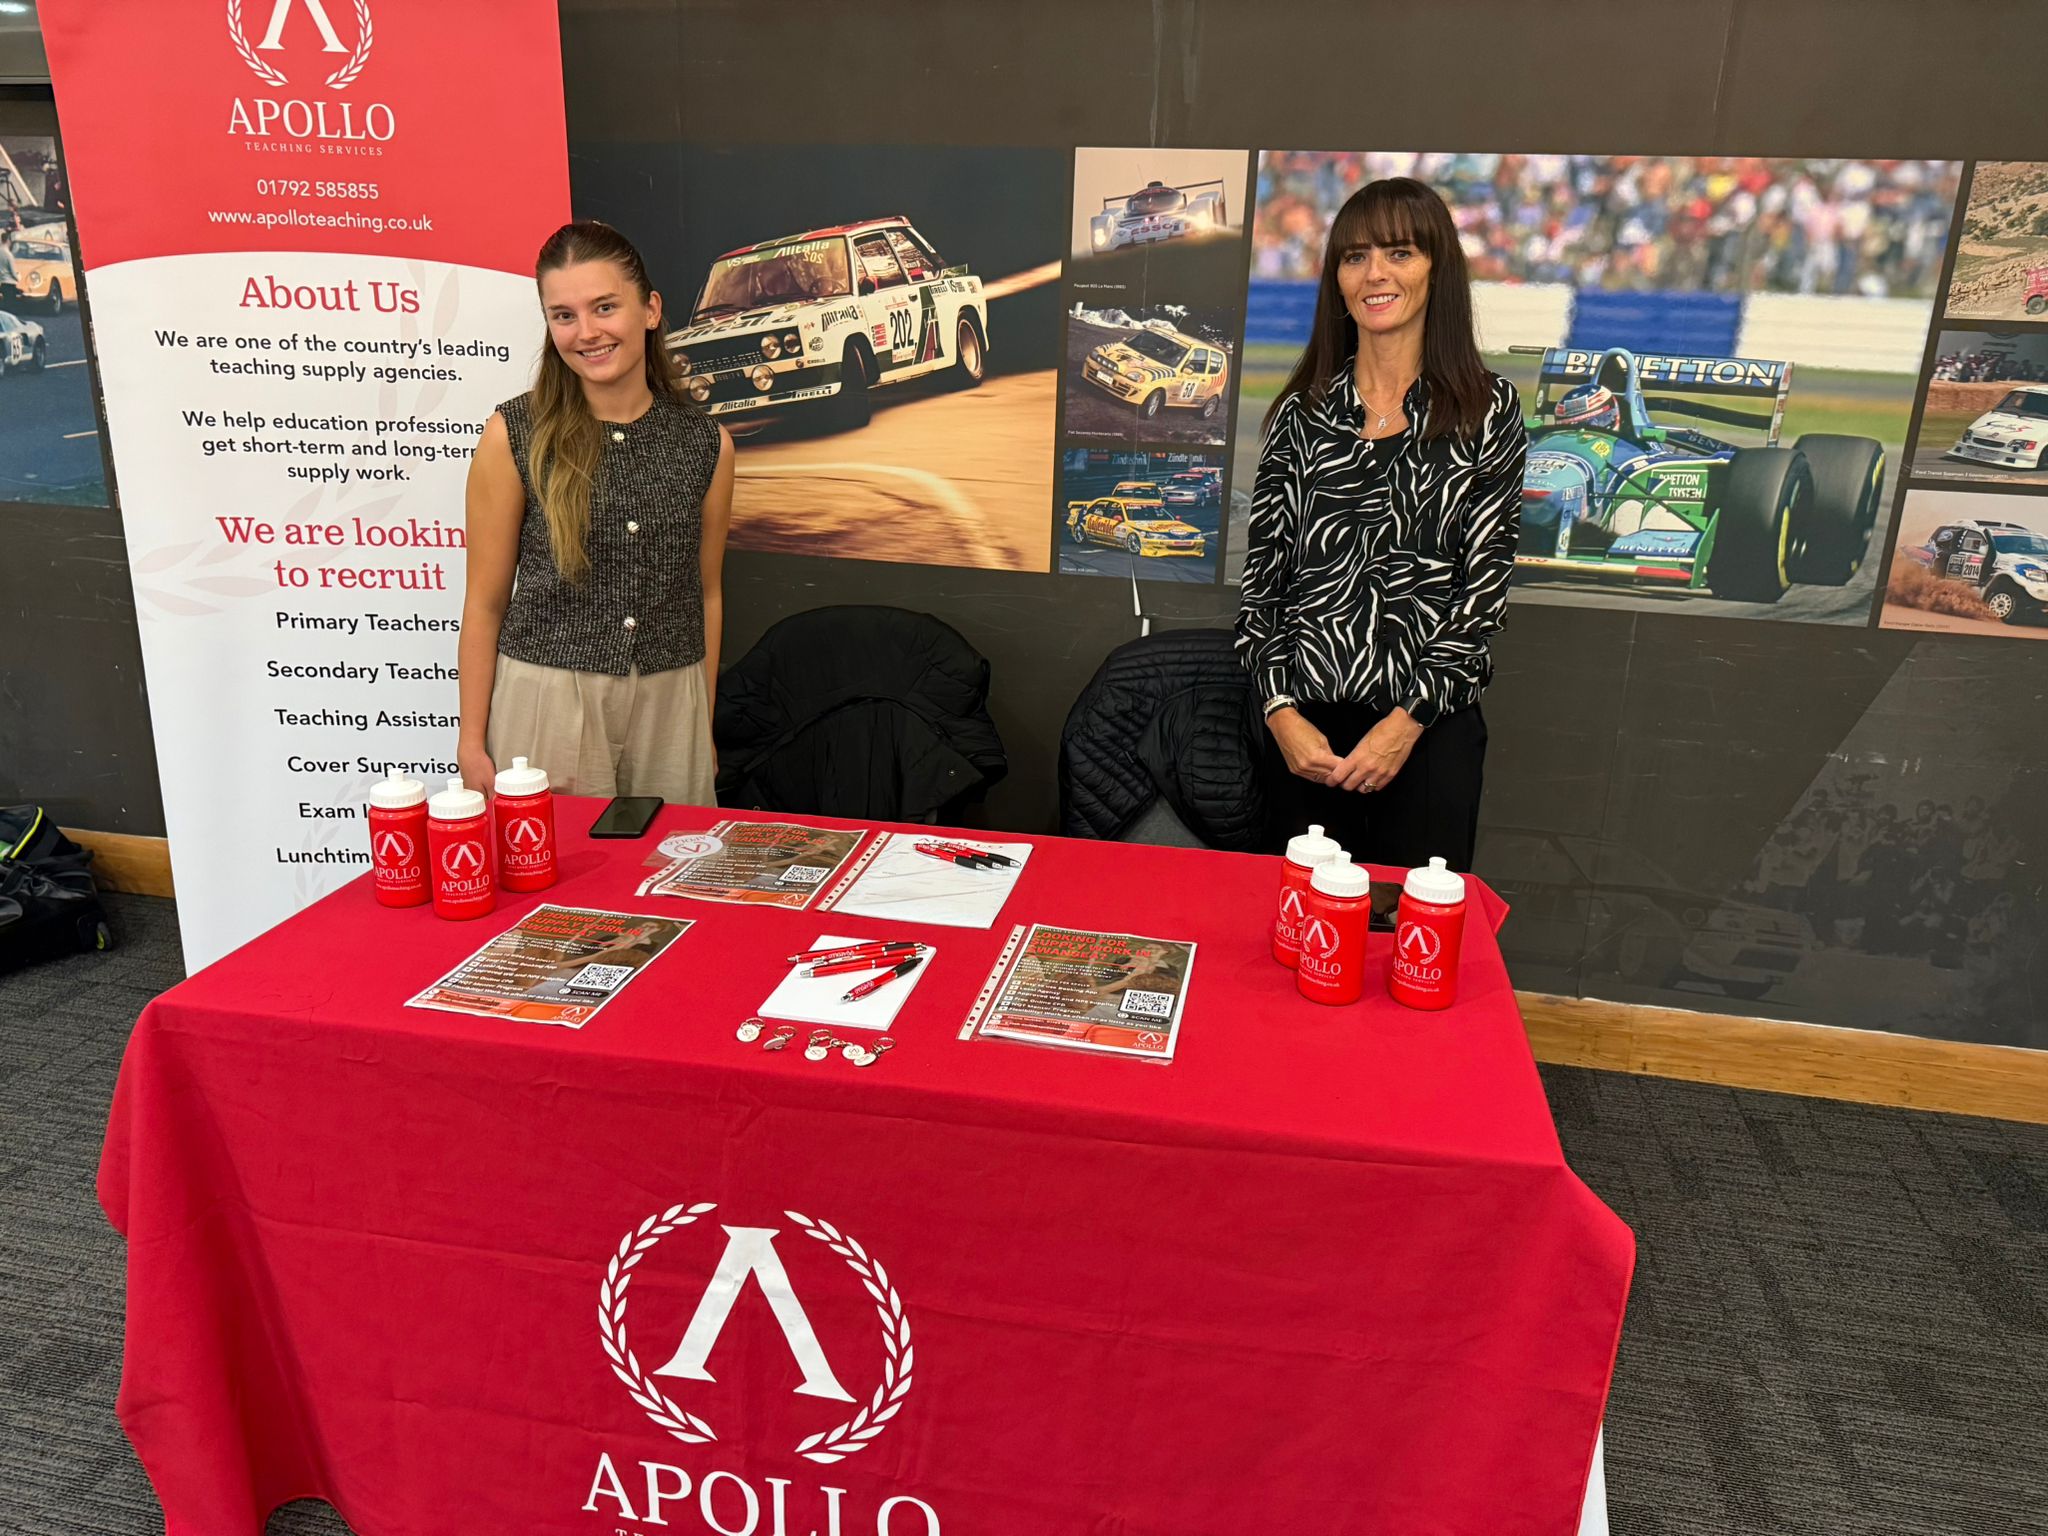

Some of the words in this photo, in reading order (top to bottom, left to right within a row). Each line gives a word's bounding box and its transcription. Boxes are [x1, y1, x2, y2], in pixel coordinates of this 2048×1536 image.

[228, 97, 395, 141] APOLLO
[245, 142, 312, 153] TEACHING
[319, 144, 383, 156] SERVICES
[257, 179, 310, 196] 01792
[316, 181, 379, 199] 585855
[208, 209, 433, 233] www.apolloteaching.co.uk
[1131, 223, 1173, 236] ESSO
[774, 241, 830, 258] Alitalia
[239, 275, 360, 311] About
[368, 281, 420, 313] Us
[890, 308, 914, 350] 202
[155, 330, 188, 347] We
[197, 334, 228, 349] are
[235, 337, 271, 350] one
[279, 334, 298, 351] of
[305, 335, 337, 352] the
[344, 339, 431, 359] country's
[438, 339, 509, 362] leading
[210, 358, 295, 379] teaching
[302, 362, 366, 382] supply
[374, 364, 462, 383] agencies.
[1182, 382, 1195, 399] 58
[719, 398, 756, 412] Alitalia
[182, 410, 216, 427] We
[224, 411, 265, 431] help
[273, 413, 368, 431] education
[202, 437, 236, 456] get
[243, 437, 345, 455] short-term
[352, 441, 387, 456] and
[287, 463, 350, 483] supply
[356, 465, 410, 480] work.
[216, 516, 275, 544] We
[285, 523, 345, 545] are
[353, 517, 467, 548] lookin
[274, 560, 309, 588] to
[318, 563, 446, 590] recruit
[1963, 564, 1979, 576] 2014
[276, 612, 358, 635] Primary
[365, 614, 460, 631] Teachers
[267, 660, 378, 683] Secondary
[385, 662, 459, 680] Teache
[274, 709, 367, 731] Teaching
[376, 710, 460, 727] Assistan
[287, 756, 349, 773] Cover
[357, 757, 460, 777] Superviso
[300, 803, 355, 818] Exam
[787, 829, 808, 837] FOR
[276, 847, 374, 863] Lunchtim
[504, 850, 550, 865] APOLLO
[374, 866, 420, 881] APOLLO
[441, 874, 490, 893] APOLLO
[528, 917, 580, 928] SUPPLY
[584, 924, 625, 933] WORK
[536, 912, 596, 923] LOOKING
[519, 922, 596, 936] SWANSEA?
[1029, 938, 1085, 950] SUPPLY
[1090, 945, 1131, 955] WORK
[1034, 931, 1096, 943] LOOKING
[1100, 939, 1127, 947] FOR
[1025, 945, 1108, 960] SWANSEA?
[473, 968, 503, 976] Approved
[1392, 956, 1441, 981] APOLLO
[1017, 991, 1048, 999] Approved
[1133, 1042, 1163, 1050] APOLLO
